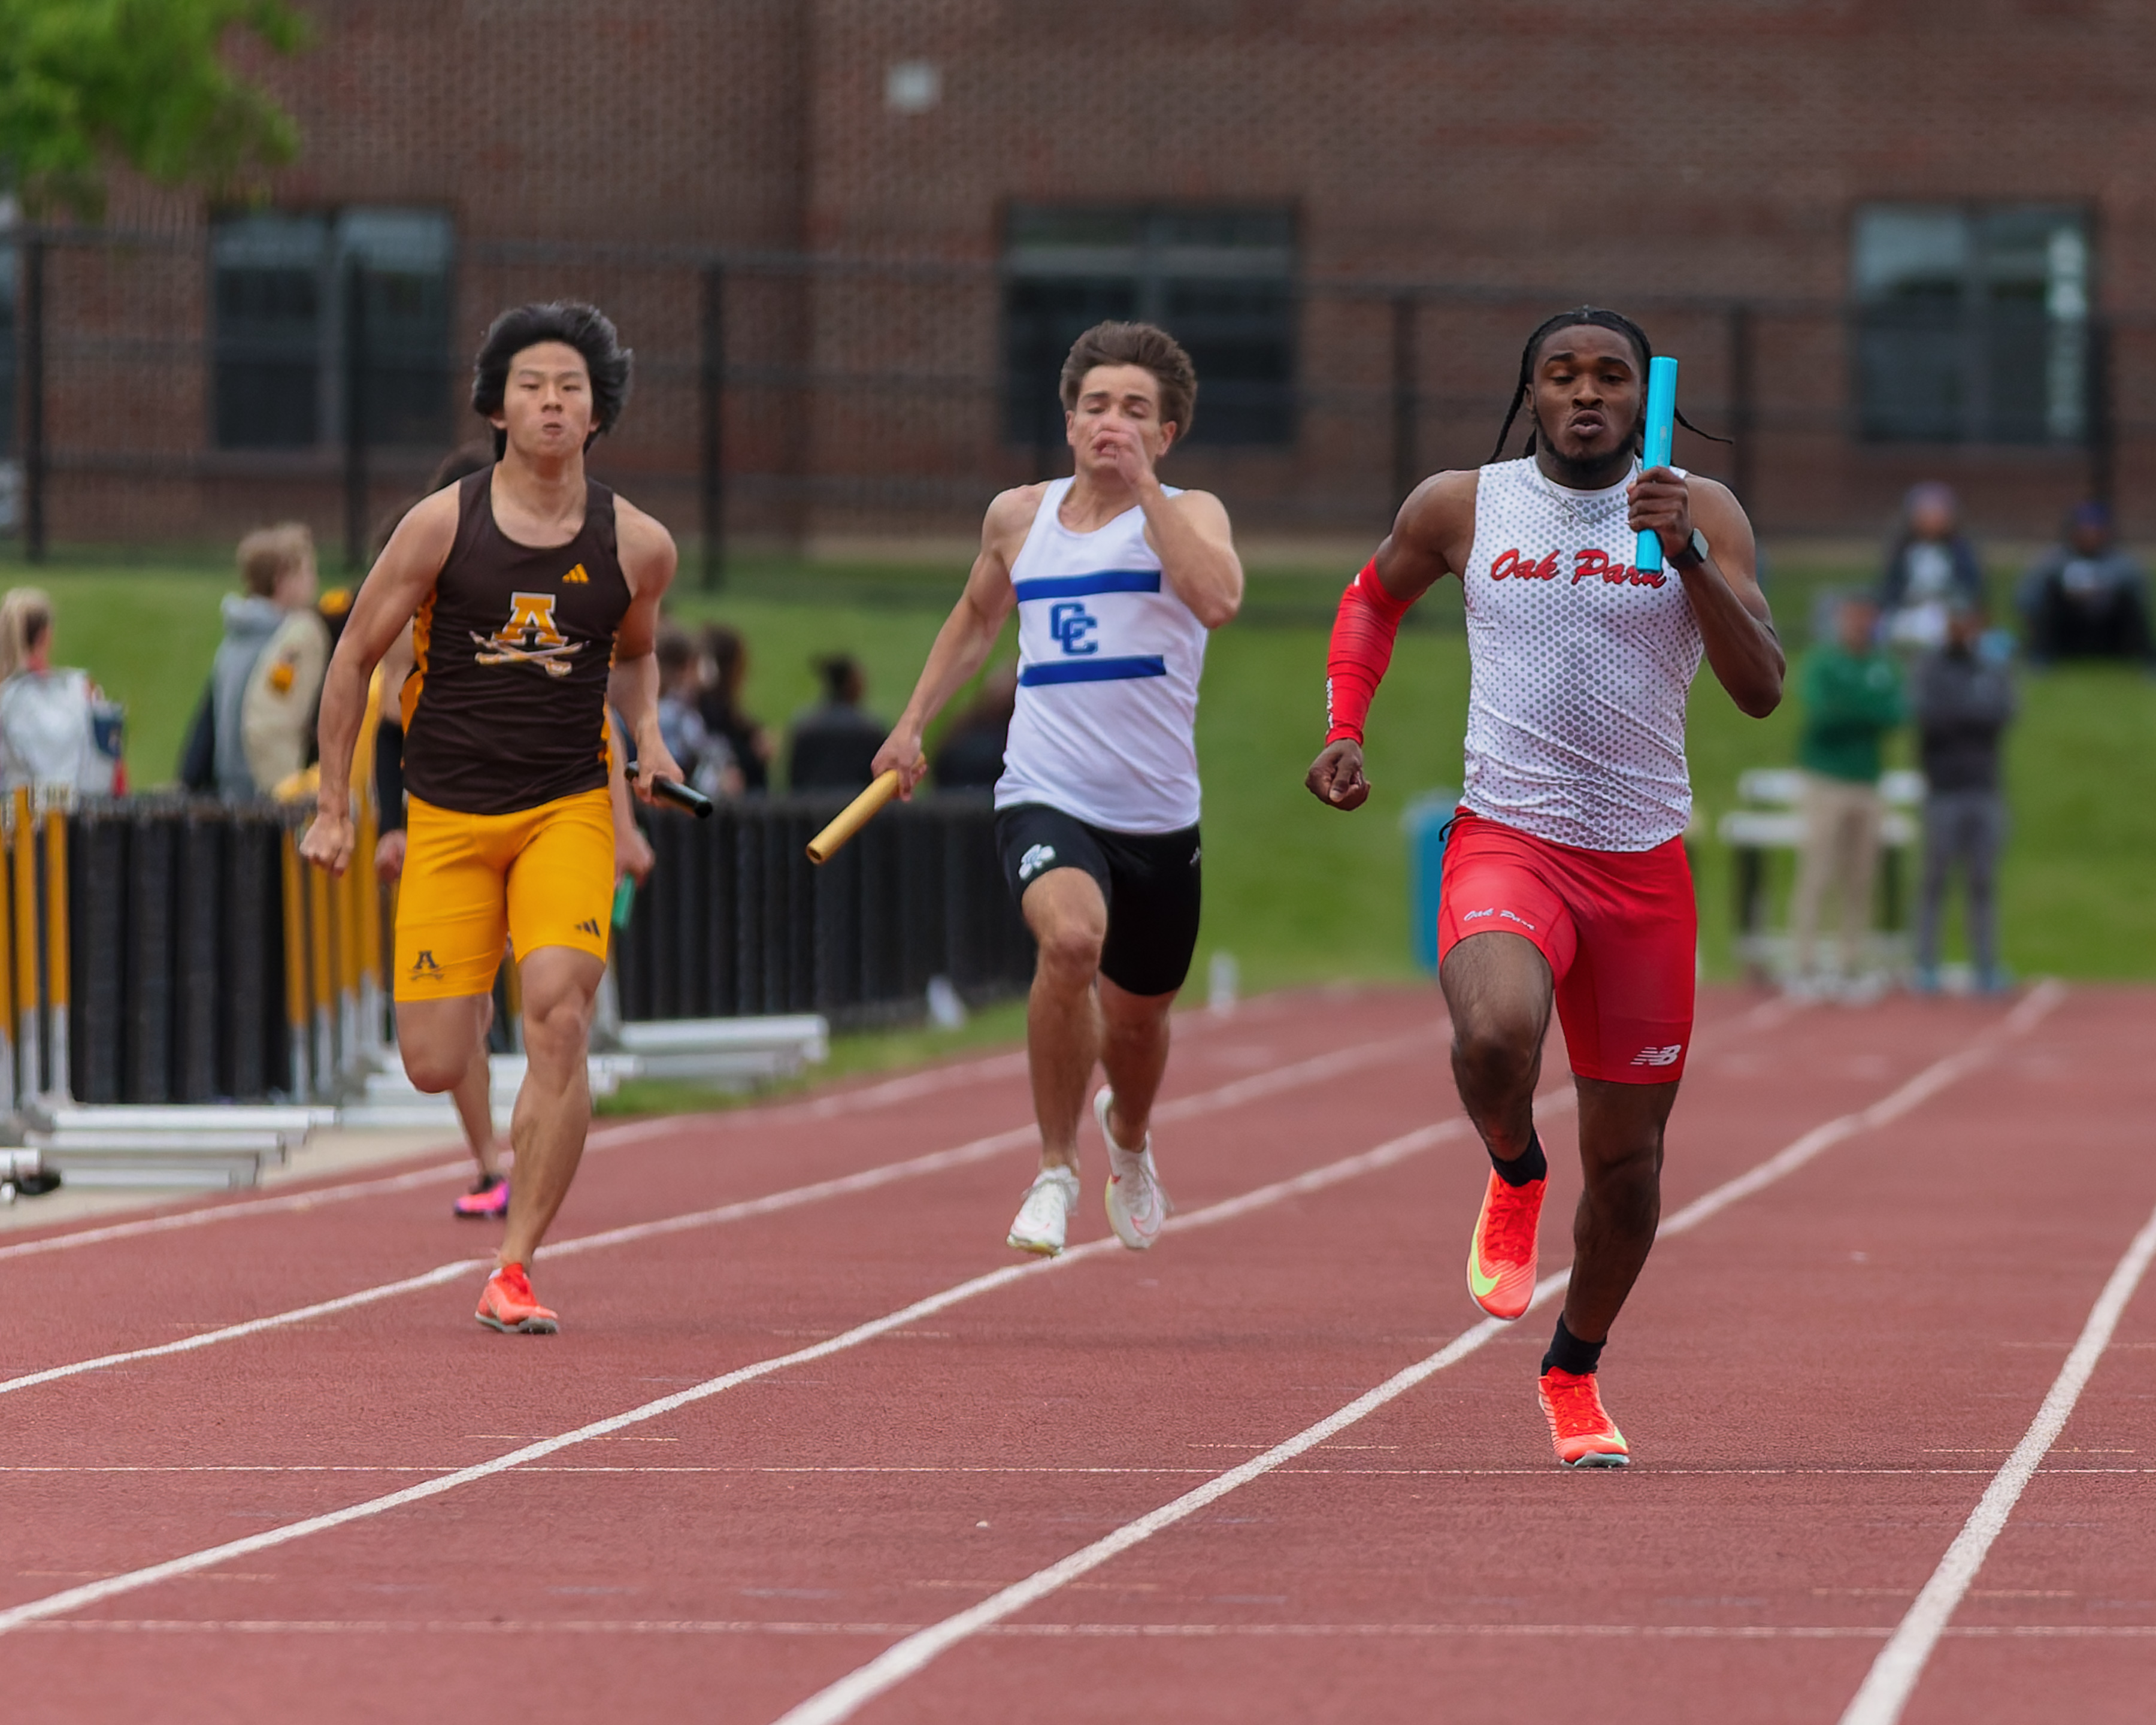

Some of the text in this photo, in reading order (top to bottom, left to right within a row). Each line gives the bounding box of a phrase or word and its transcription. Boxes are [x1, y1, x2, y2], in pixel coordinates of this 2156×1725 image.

[1491, 548, 1560, 581] Oak
[490, 591, 568, 647] A
[1049, 603, 1098, 655] CC
[413, 950, 440, 970] A
